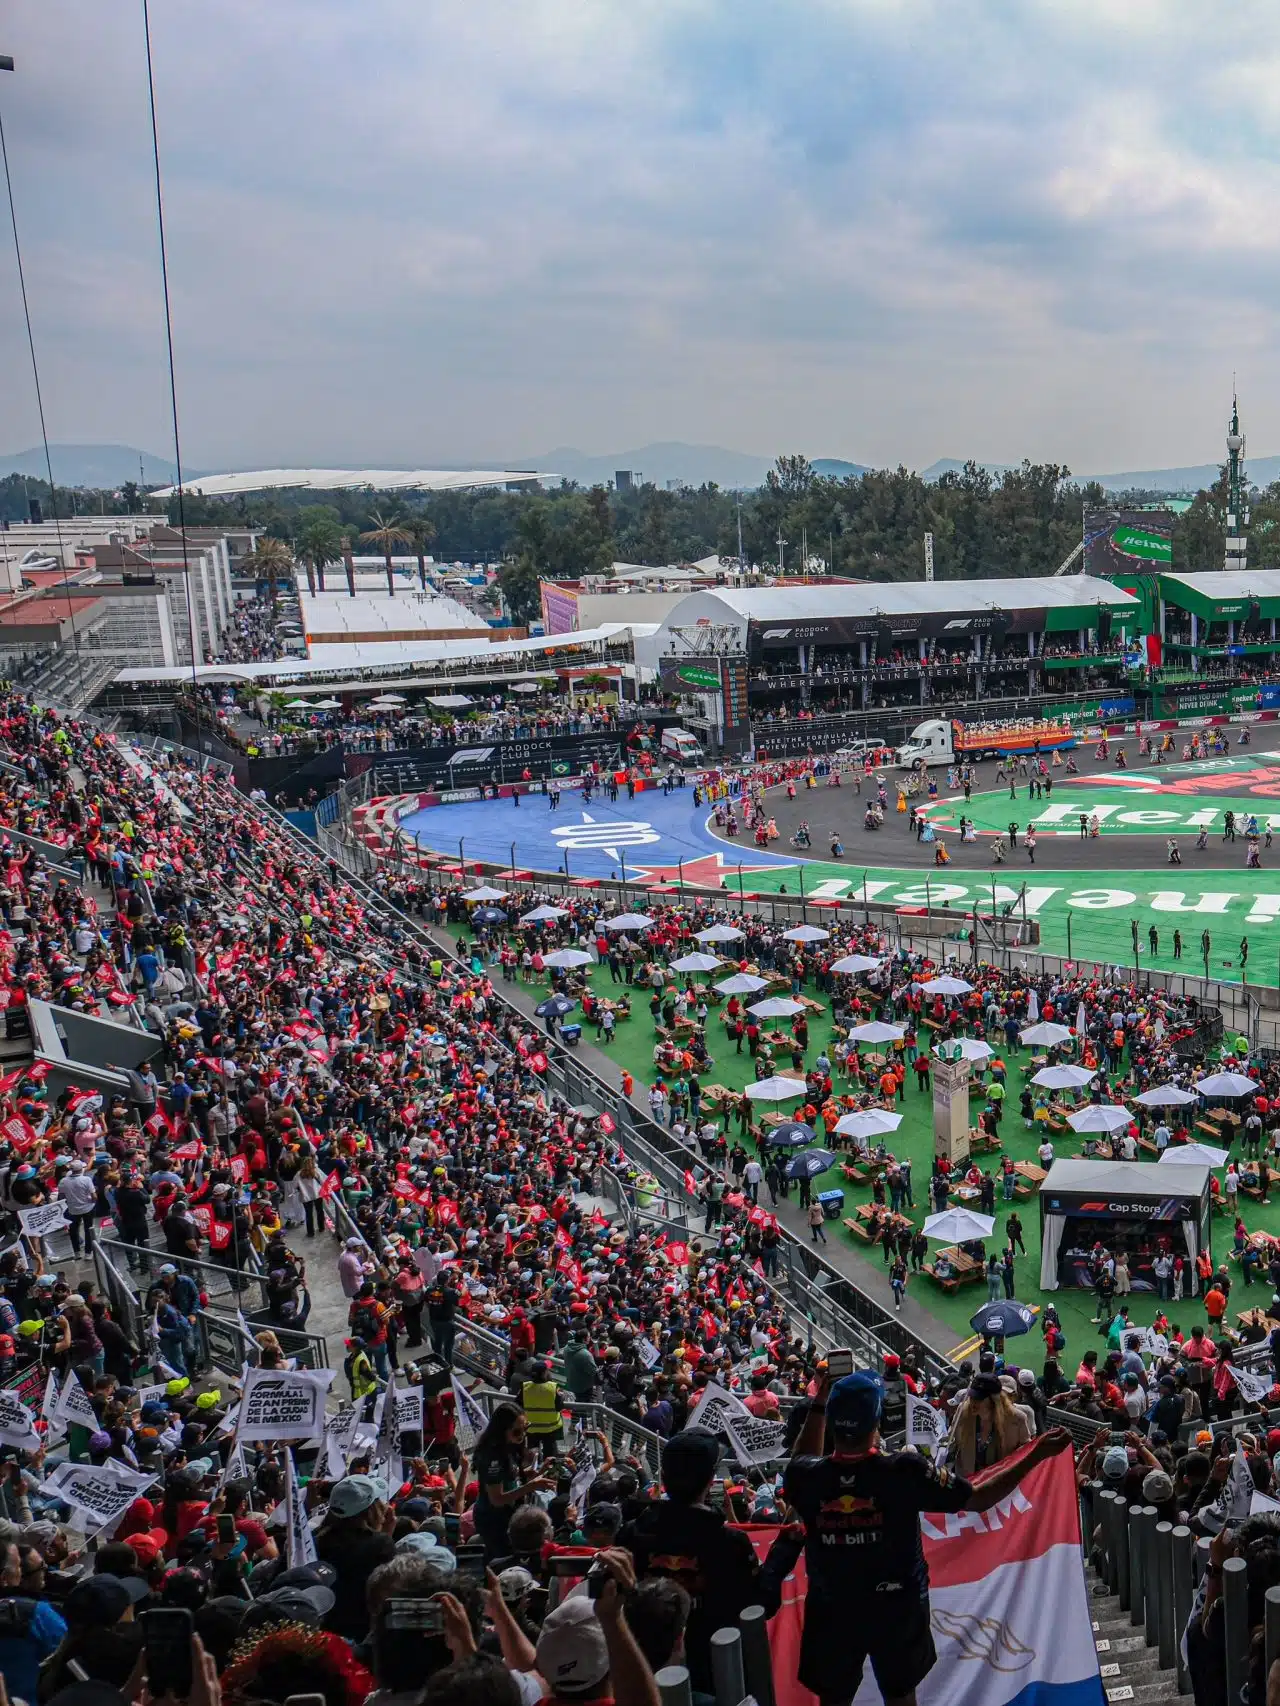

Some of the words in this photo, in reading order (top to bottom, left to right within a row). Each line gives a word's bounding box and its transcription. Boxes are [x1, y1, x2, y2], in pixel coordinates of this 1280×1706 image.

[768, 679, 815, 689] WHERE
[824, 671, 909, 685] ADRENALINE
[918, 668, 958, 677] MEETS
[966, 663, 1028, 674] ELEGANCE
[1200, 700, 1218, 708] DRINK
[807, 732, 846, 741] FORMULA
[500, 742, 552, 753] PADDOCK
[501, 751, 530, 760] CLUB
[1108, 1203, 1129, 1214] Cap
[1131, 1203, 1161, 1213] Store
[249, 1399, 280, 1407] GRAN
[263, 1407, 278, 1415] LA
[246, 1416, 260, 1424] DE
